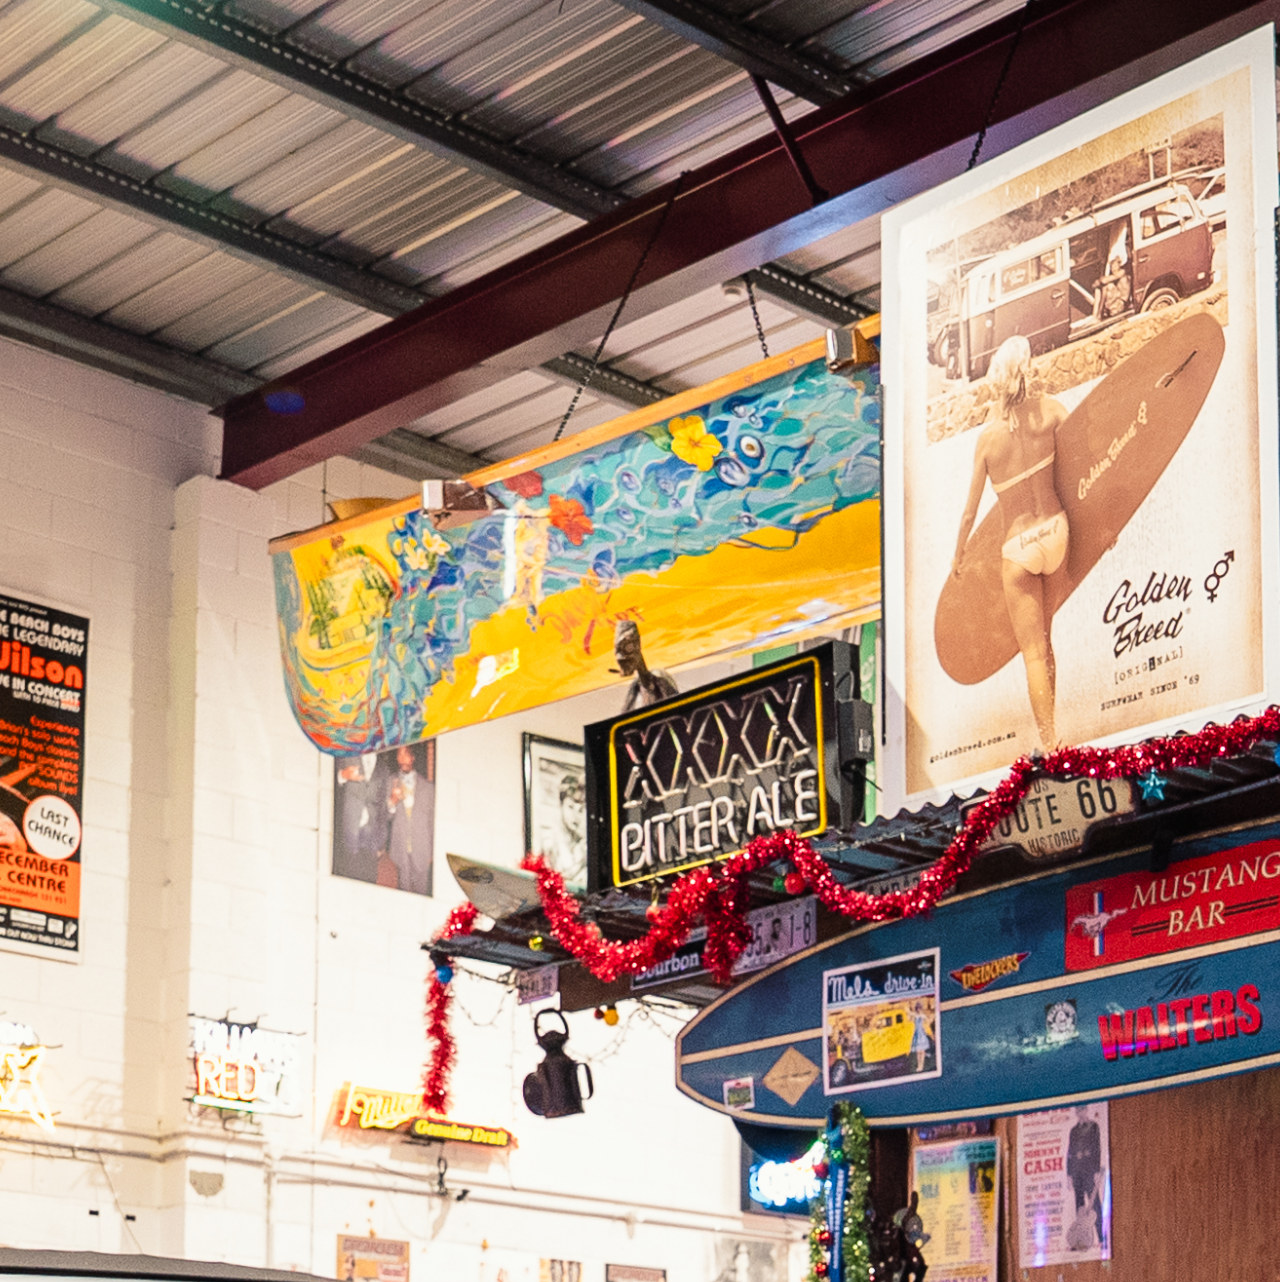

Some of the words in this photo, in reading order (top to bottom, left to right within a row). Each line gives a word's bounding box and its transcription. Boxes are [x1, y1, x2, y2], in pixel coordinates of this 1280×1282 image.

[1103, 571, 1192, 624] Golden
[10, 613, 49, 633] BEACH
[52, 623, 85, 643] BOYS
[13, 627, 84, 657] LEGENDARY
[1113, 612, 1183, 658] Breed
[12, 679, 25, 692] IN
[28, 682, 80, 703] CONCERT
[1150, 681, 1178, 698] SINCE
[30, 715, 80, 735] Experience
[623, 674, 812, 809] XXXX
[929, 732, 1016, 764] goldenbreed.com.au
[38, 766, 79, 784] SOUNDS
[1032, 782, 1049, 795] US
[41, 807, 69, 827] LAST
[746, 769, 818, 836] ALE
[988, 793, 1062, 842] OUTE
[1076, 779, 1118, 820] 66
[28, 820, 75, 848] CHANCE
[1028, 829, 1081, 854] HISTORIC
[8, 871, 66, 893] CENTRE
[1168, 901, 1226, 937] BAR
[828, 974, 881, 1002] Mels
[884, 970, 936, 993] drive-in
[1150, 962, 1204, 1001] The
[1098, 983, 1263, 1062] WALTERS
[196, 1053, 258, 1101] RED
[414, 1120, 471, 1141] Genuine
[471, 1127, 509, 1146] Draft
[1024, 1158, 1063, 1176] CASH
